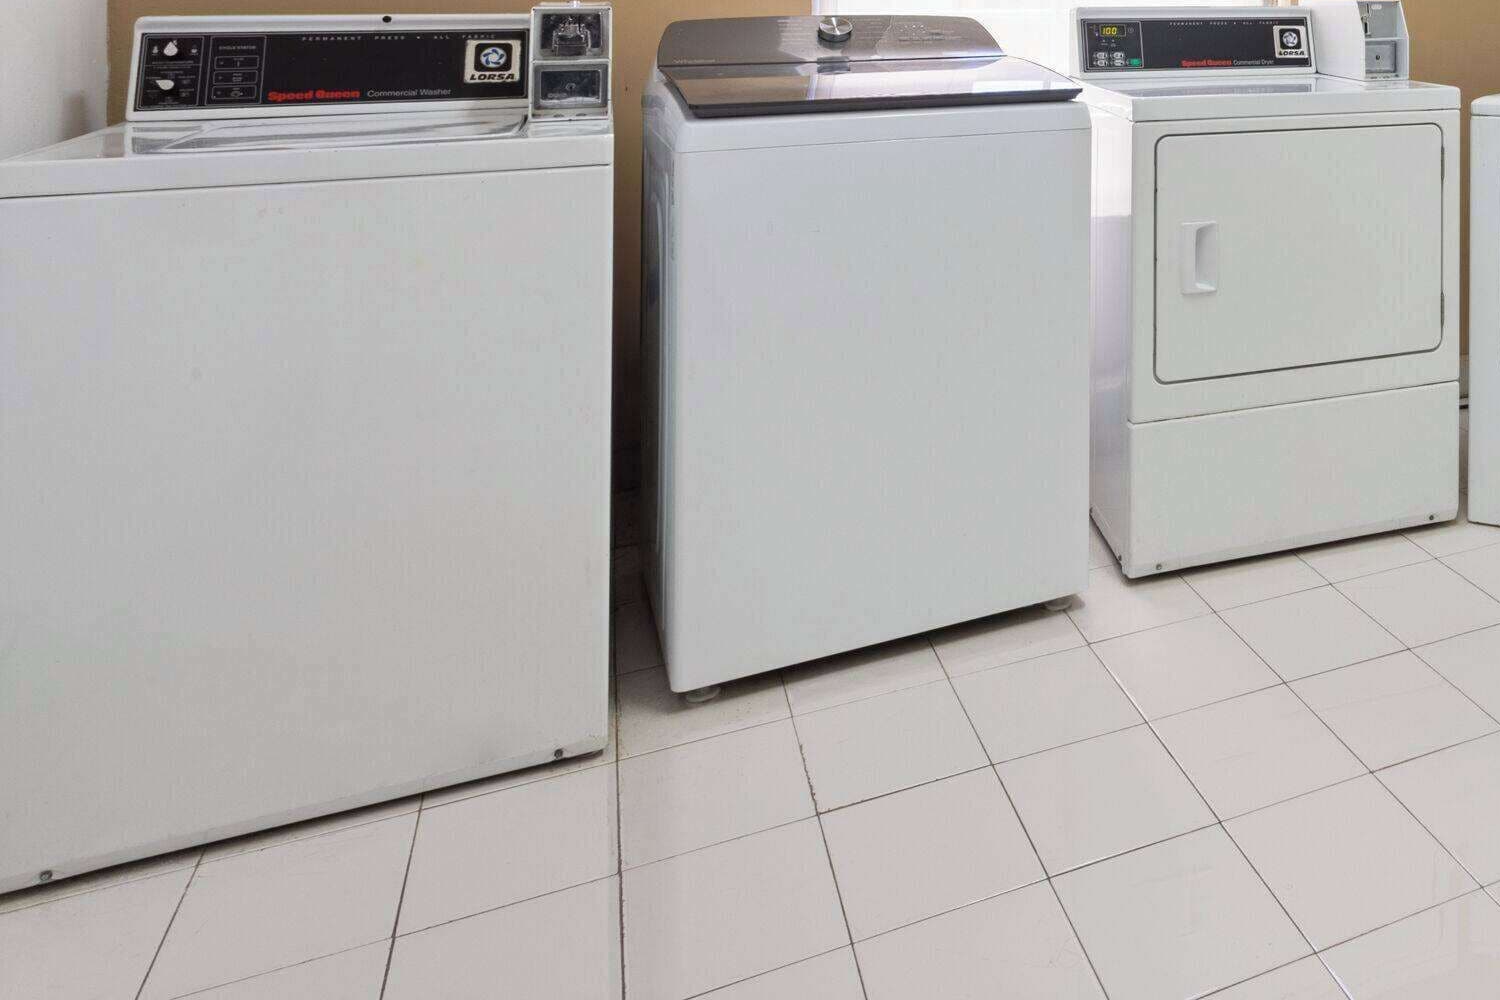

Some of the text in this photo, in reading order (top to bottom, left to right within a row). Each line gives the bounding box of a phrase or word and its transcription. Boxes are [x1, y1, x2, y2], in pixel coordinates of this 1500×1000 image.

[1102, 26, 1118, 35] 100
[1181, 59, 1207, 67] Speed
[469, 73, 515, 81] LORSA
[267, 88, 452, 101] Speed Queen Commercial Washer
